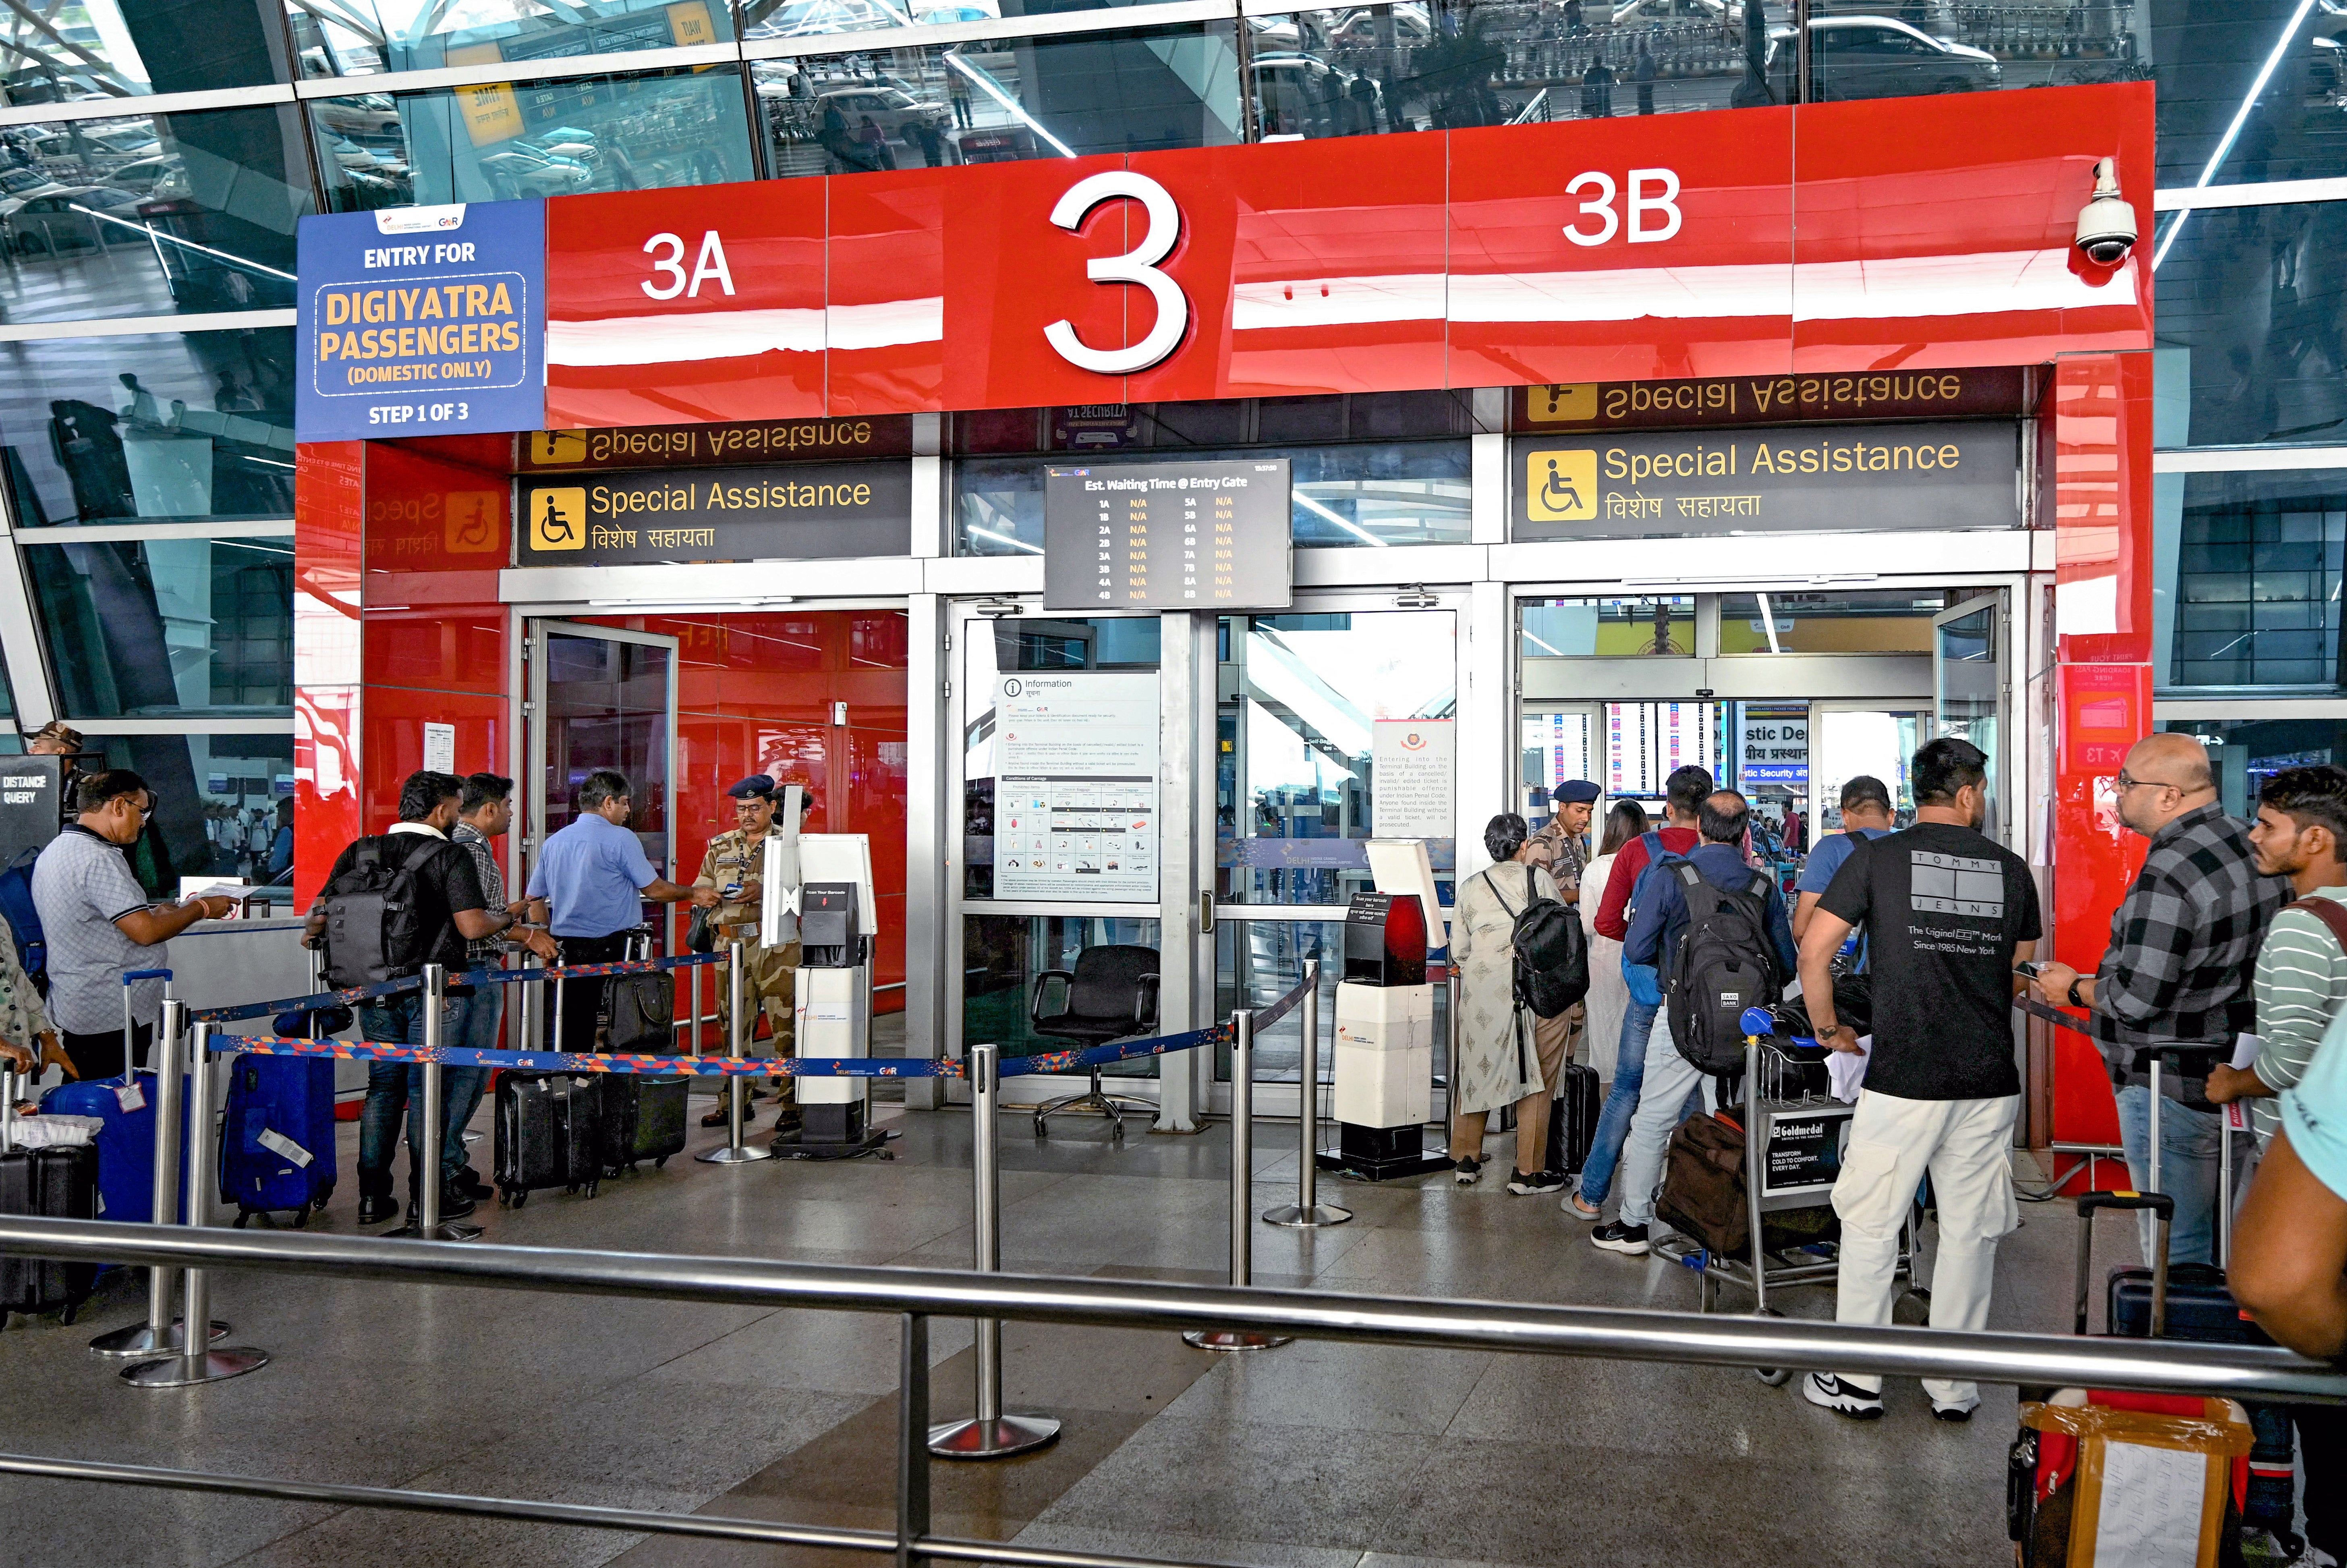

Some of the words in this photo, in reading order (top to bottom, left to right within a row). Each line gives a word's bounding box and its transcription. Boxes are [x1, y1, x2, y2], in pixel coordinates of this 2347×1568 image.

[1562, 168, 1681, 246] 3B
[365, 246, 429, 268] ENTRY
[435, 243, 475, 263] FOR
[641, 230, 735, 300] 3A
[1043, 171, 1188, 373] 3
[327, 283, 513, 325] DIGIYATRA
[320, 321, 519, 361] PASSENGERS
[348, 364, 437, 385] (DOMESTIC
[442, 360, 491, 379] ONLY)
[369, 406, 413, 424] STEP
[418, 406, 426, 421] 1
[430, 404, 453, 421] OF
[459, 403, 469, 420] 3
[1605, 444, 1736, 485] Special
[1751, 441, 1961, 475] Assistance
[1085, 480, 1105, 491] Est.
[1107, 479, 1148, 492] Waiting
[1150, 478, 1176, 489] Time
[1178, 479, 1188, 489] @
[1190, 478, 1220, 490] Entry
[1222, 477, 1248, 487] Gate
[591, 483, 695, 518] Special
[707, 481, 871, 510] Assistance
[1099, 500, 1111, 508] 1A
[1130, 499, 1147, 508] N/A
[1184, 498, 1196, 506] 5A
[1215, 497, 1233, 505] N/A
[1605, 491, 1663, 520] विशेष
[1676, 495, 1761, 518] सहायता
[1099, 513, 1109, 521] 1B
[1130, 512, 1147, 521] N/A
[1184, 511, 1196, 520] 5B
[1215, 510, 1233, 519] N/A
[591, 524, 637, 550] विशेष
[647, 528, 714, 548] सहायता
[1099, 526, 1111, 535] 2A
[1130, 525, 1147, 534] N/A
[1184, 524, 1196, 533] 6A
[1215, 524, 1233, 532] N/A
[1099, 539, 1109, 548] 2B
[1130, 538, 1147, 547] N/A
[1184, 537, 1196, 546] 6B
[1215, 537, 1233, 545] N/A
[1099, 552, 1111, 561] 3A
[1130, 552, 1147, 560] N/A
[1184, 551, 1196, 559] 7A
[1215, 550, 1233, 558] N/A
[1099, 565, 1109, 574] 3B
[1130, 565, 1147, 573] N/A
[1184, 564, 1196, 572] 7B
[1215, 563, 1233, 572] N/A
[1099, 578, 1111, 587] 4A
[1130, 578, 1147, 586] N/A
[1184, 577, 1196, 585] 8A
[1215, 576, 1233, 585] N/A
[1099, 591, 1109, 599] 4B
[1130, 591, 1147, 599] N/A
[1184, 590, 1196, 598] 8B
[1215, 589, 1233, 597] N/A
[1760, 768, 1793, 778] Security
[3, 776, 46, 788] DISTANCE
[4, 792, 36, 804] QUERY
[1917, 853, 1996, 870] TOMMY
[1918, 899, 1998, 914] JEANS
[1908, 926, 1923, 934] The
[1982, 933, 2002, 942] Mark
[1914, 941, 1935, 950] Since
[1938, 943, 1955, 952] 1985
[1957, 944, 1976, 954] New
[1781, 1123, 1823, 1137] Goldmedal
